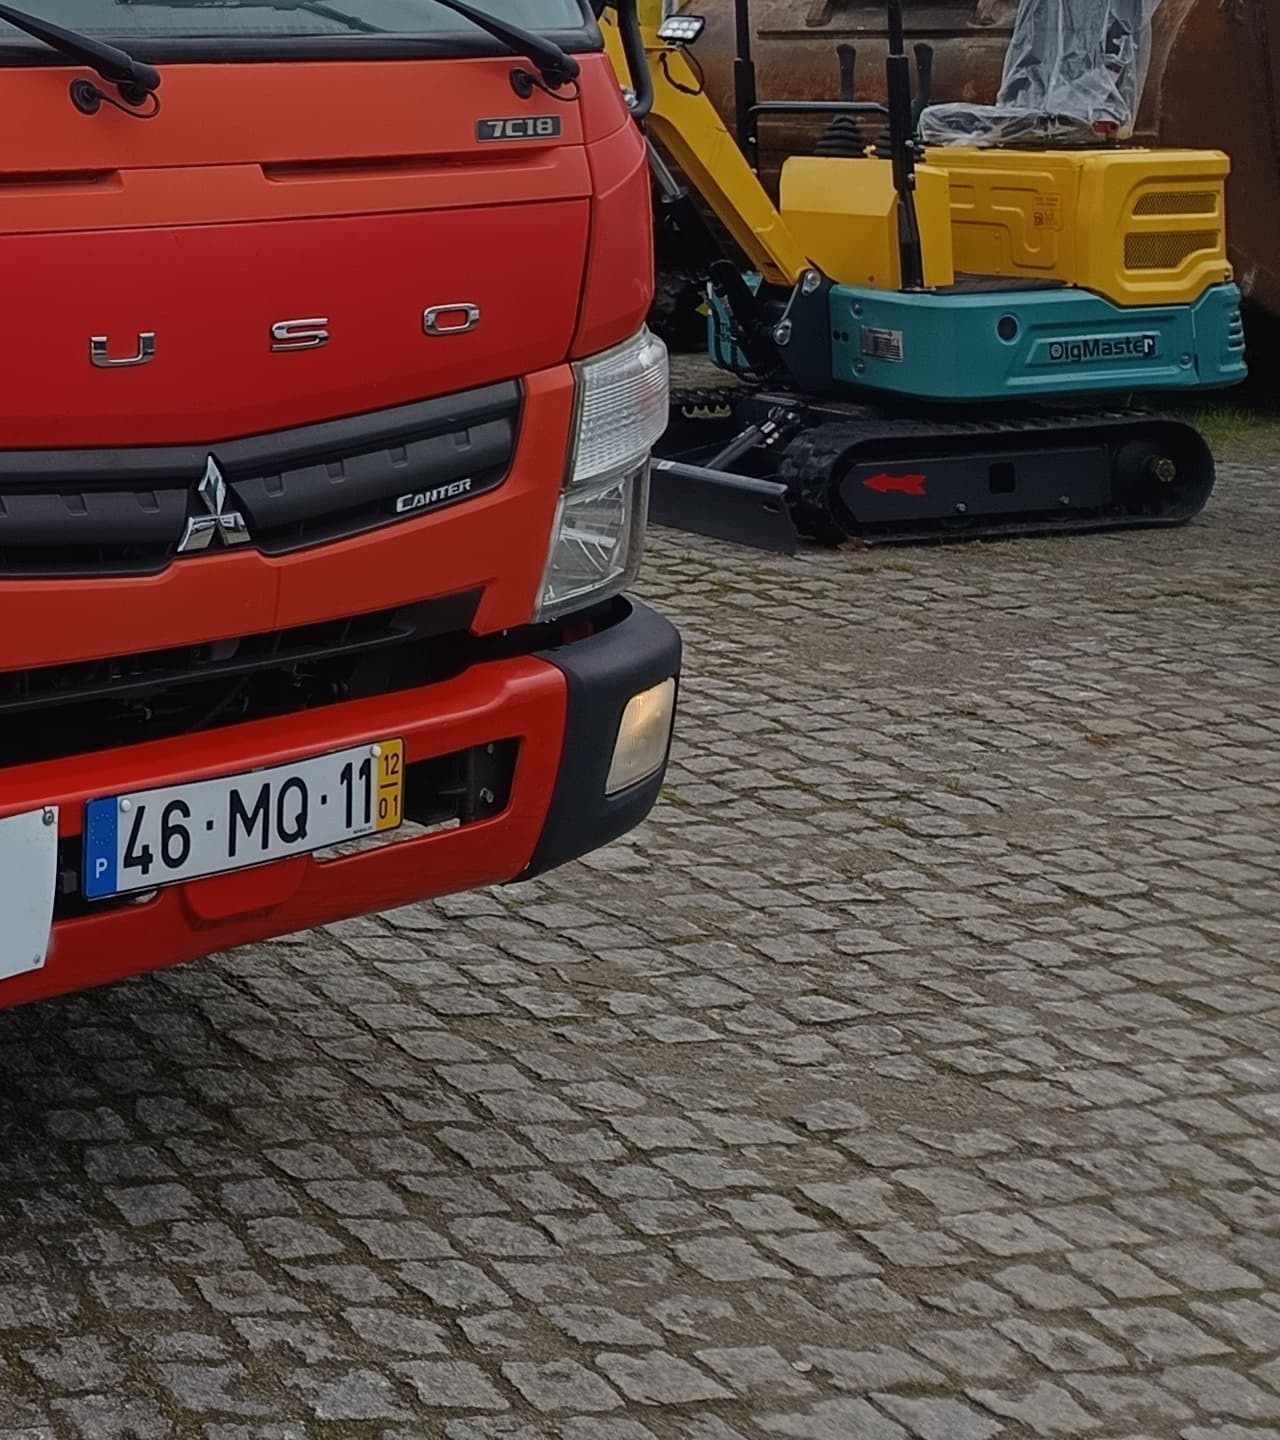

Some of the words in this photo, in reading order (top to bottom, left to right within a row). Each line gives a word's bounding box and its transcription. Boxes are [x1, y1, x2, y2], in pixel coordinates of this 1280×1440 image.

[487, 118, 553, 137] 7C18
[1049, 335, 1156, 361] DigMaster
[383, 752, 400, 777] 12
[95, 857, 108, 879] P
